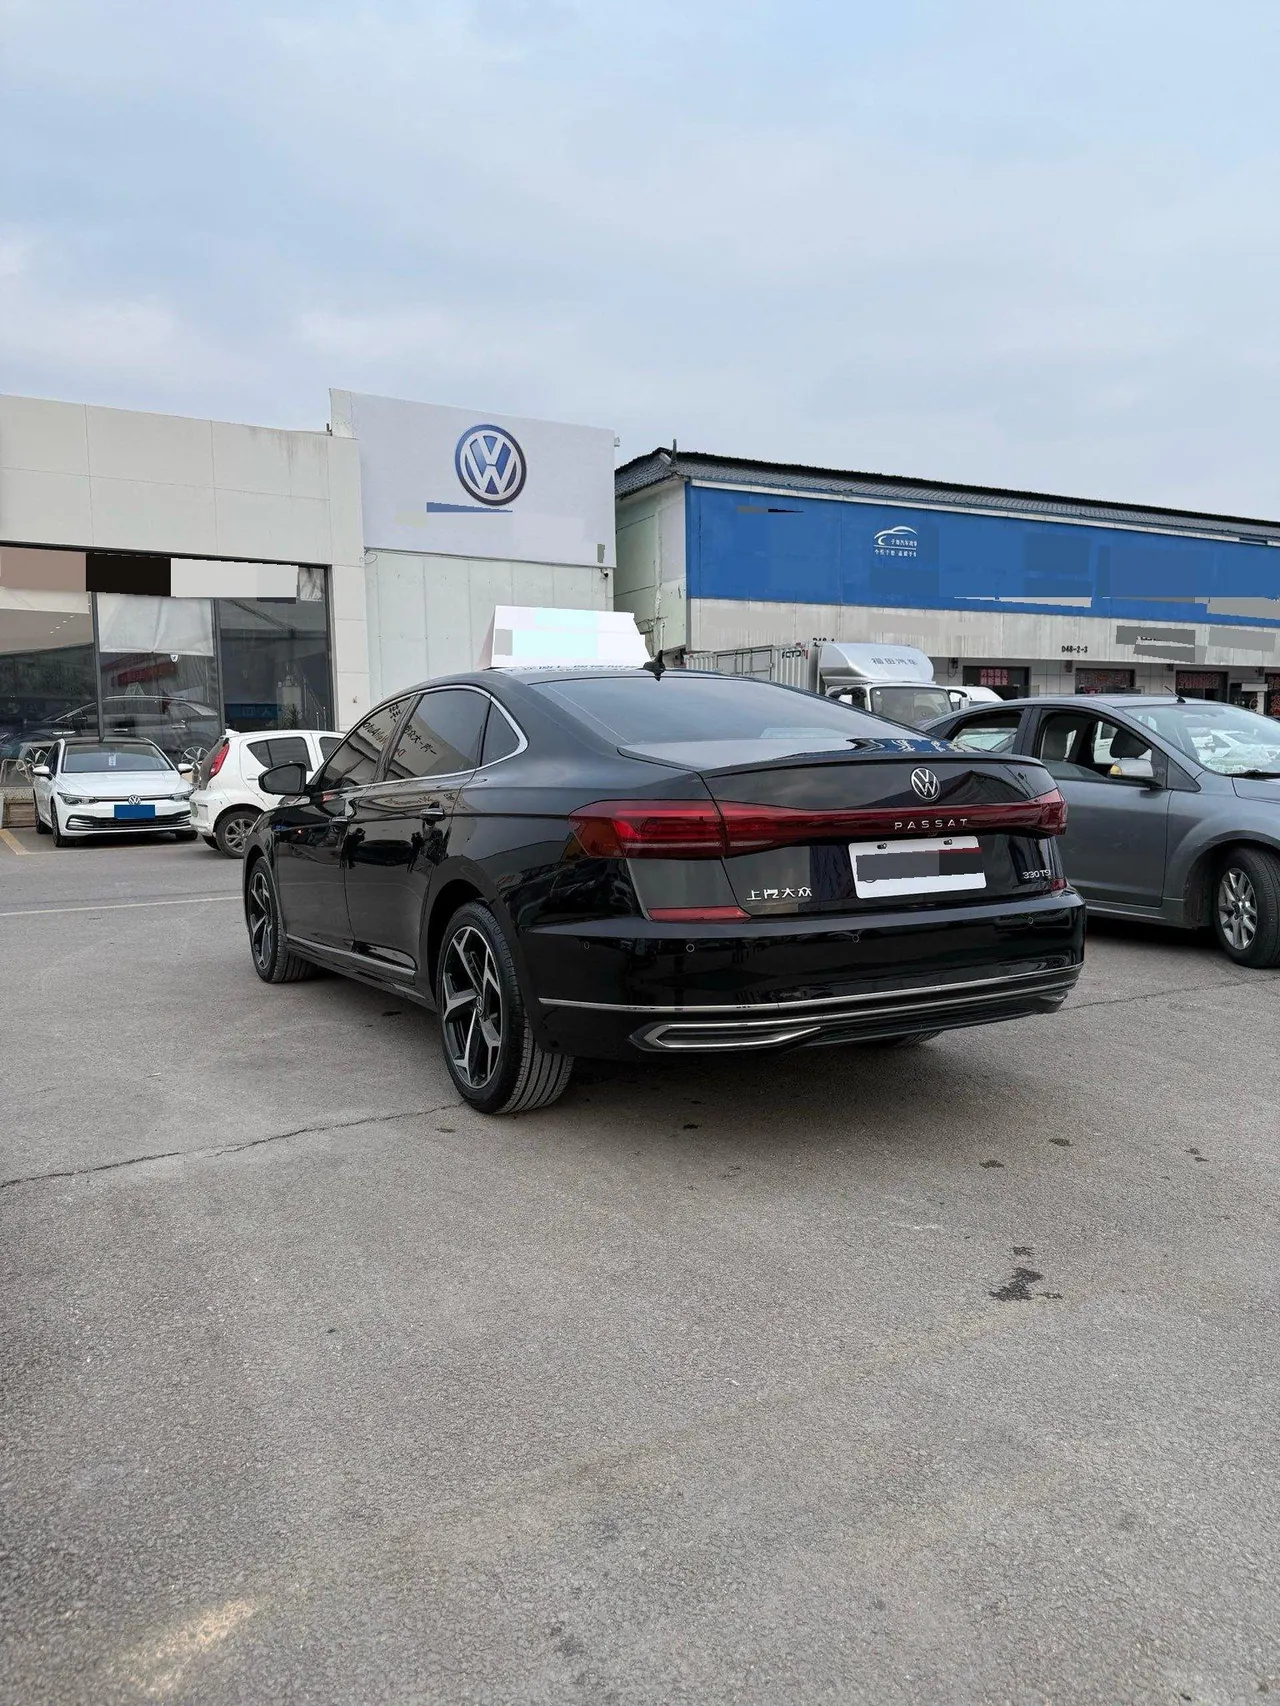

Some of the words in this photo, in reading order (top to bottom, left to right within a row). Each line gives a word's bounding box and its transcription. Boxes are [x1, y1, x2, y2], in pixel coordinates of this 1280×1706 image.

[894, 818, 968, 830] PASSAT
[1023, 870, 1040, 879] 330
[746, 886, 812, 900] 上汽大众
